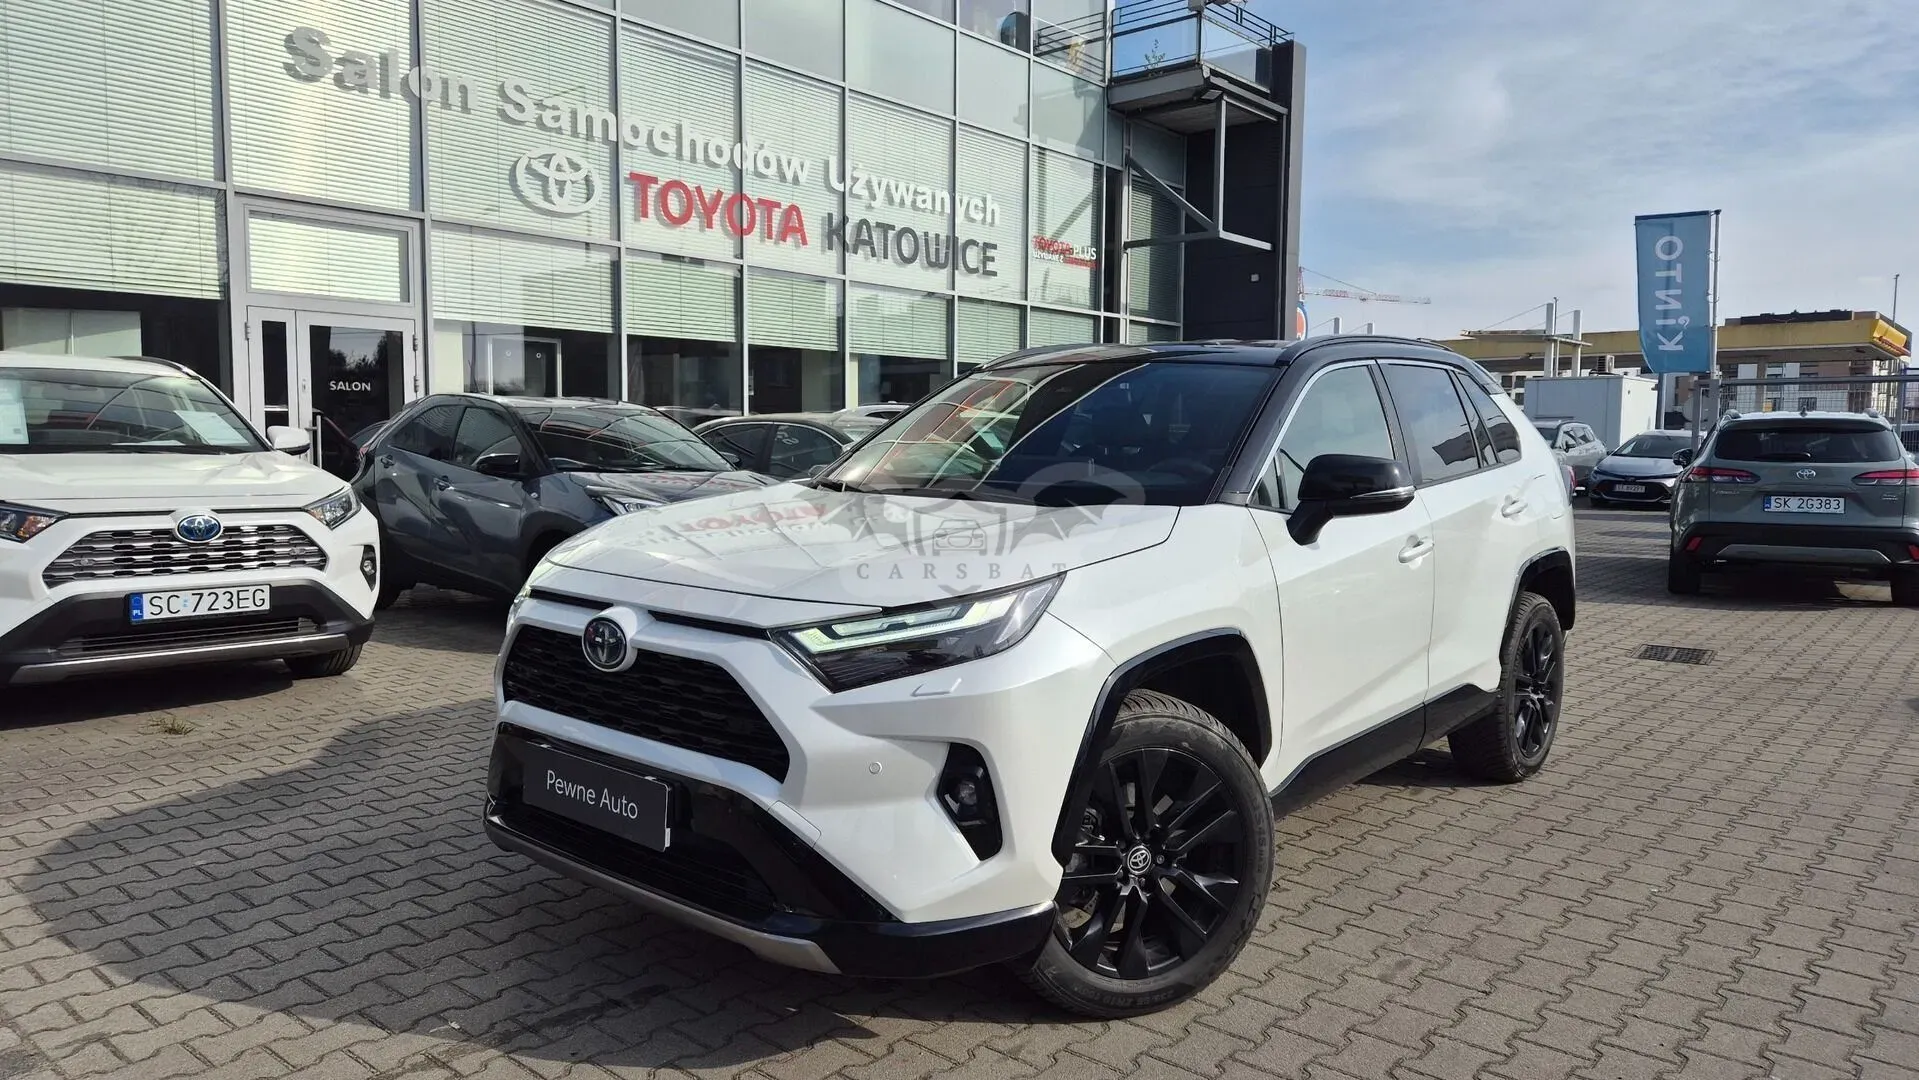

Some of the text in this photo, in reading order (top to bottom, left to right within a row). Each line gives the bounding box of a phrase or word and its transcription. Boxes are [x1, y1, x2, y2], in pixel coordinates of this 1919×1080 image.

[287, 25, 1001, 226] Salon Samochodów Używanych
[629, 172, 998, 277] TOYOTA KATOWICE
[329, 380, 371, 392] SALON
[1774, 497, 1791, 509] SK
[1797, 498, 1841, 510] 2G383
[149, 588, 266, 616] SC 723EG
[546, 769, 638, 819] Pewne Auto
